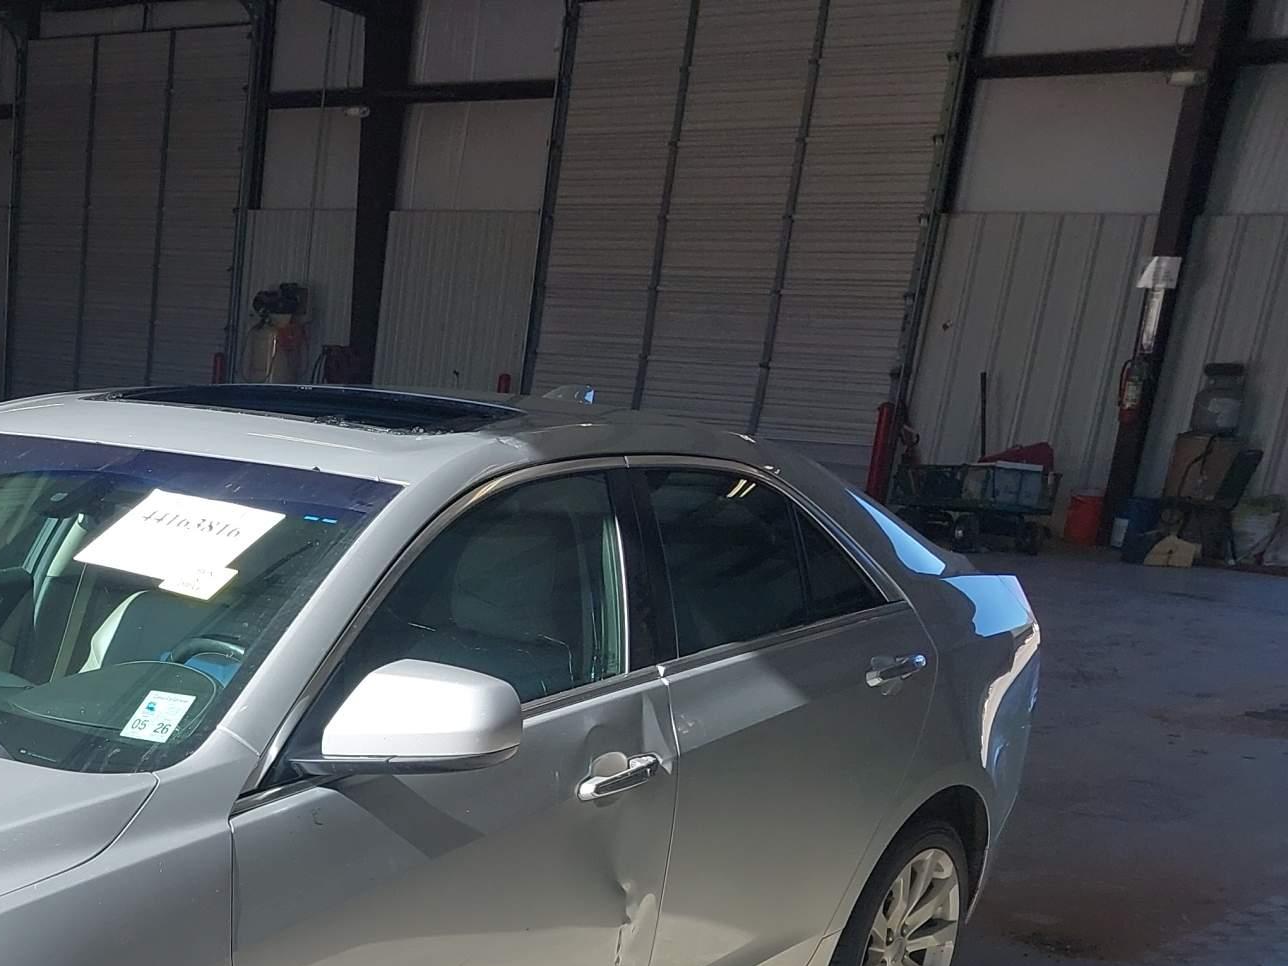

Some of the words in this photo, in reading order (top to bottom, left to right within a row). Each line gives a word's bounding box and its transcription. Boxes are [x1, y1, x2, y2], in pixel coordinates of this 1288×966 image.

[142, 510, 241, 537] 44163816
[131, 718, 149, 730] 05
[153, 722, 172, 735] 26
